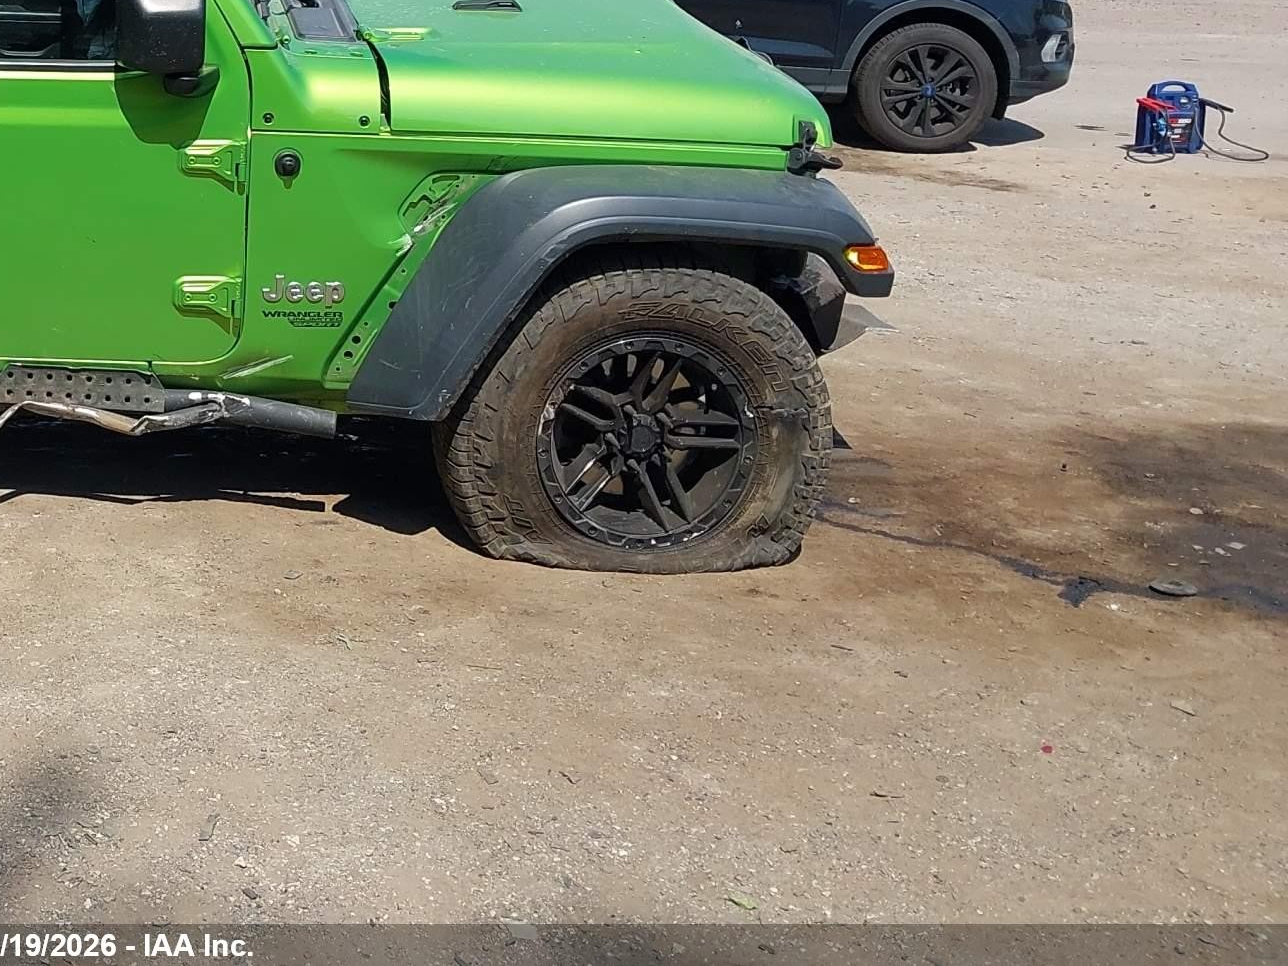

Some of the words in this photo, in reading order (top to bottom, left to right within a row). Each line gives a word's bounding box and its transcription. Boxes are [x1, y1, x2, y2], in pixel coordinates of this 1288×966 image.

[261, 273, 345, 309] Jeep
[262, 310, 343, 318] WRANGLER
[616, 300, 791, 393] FALKEN
